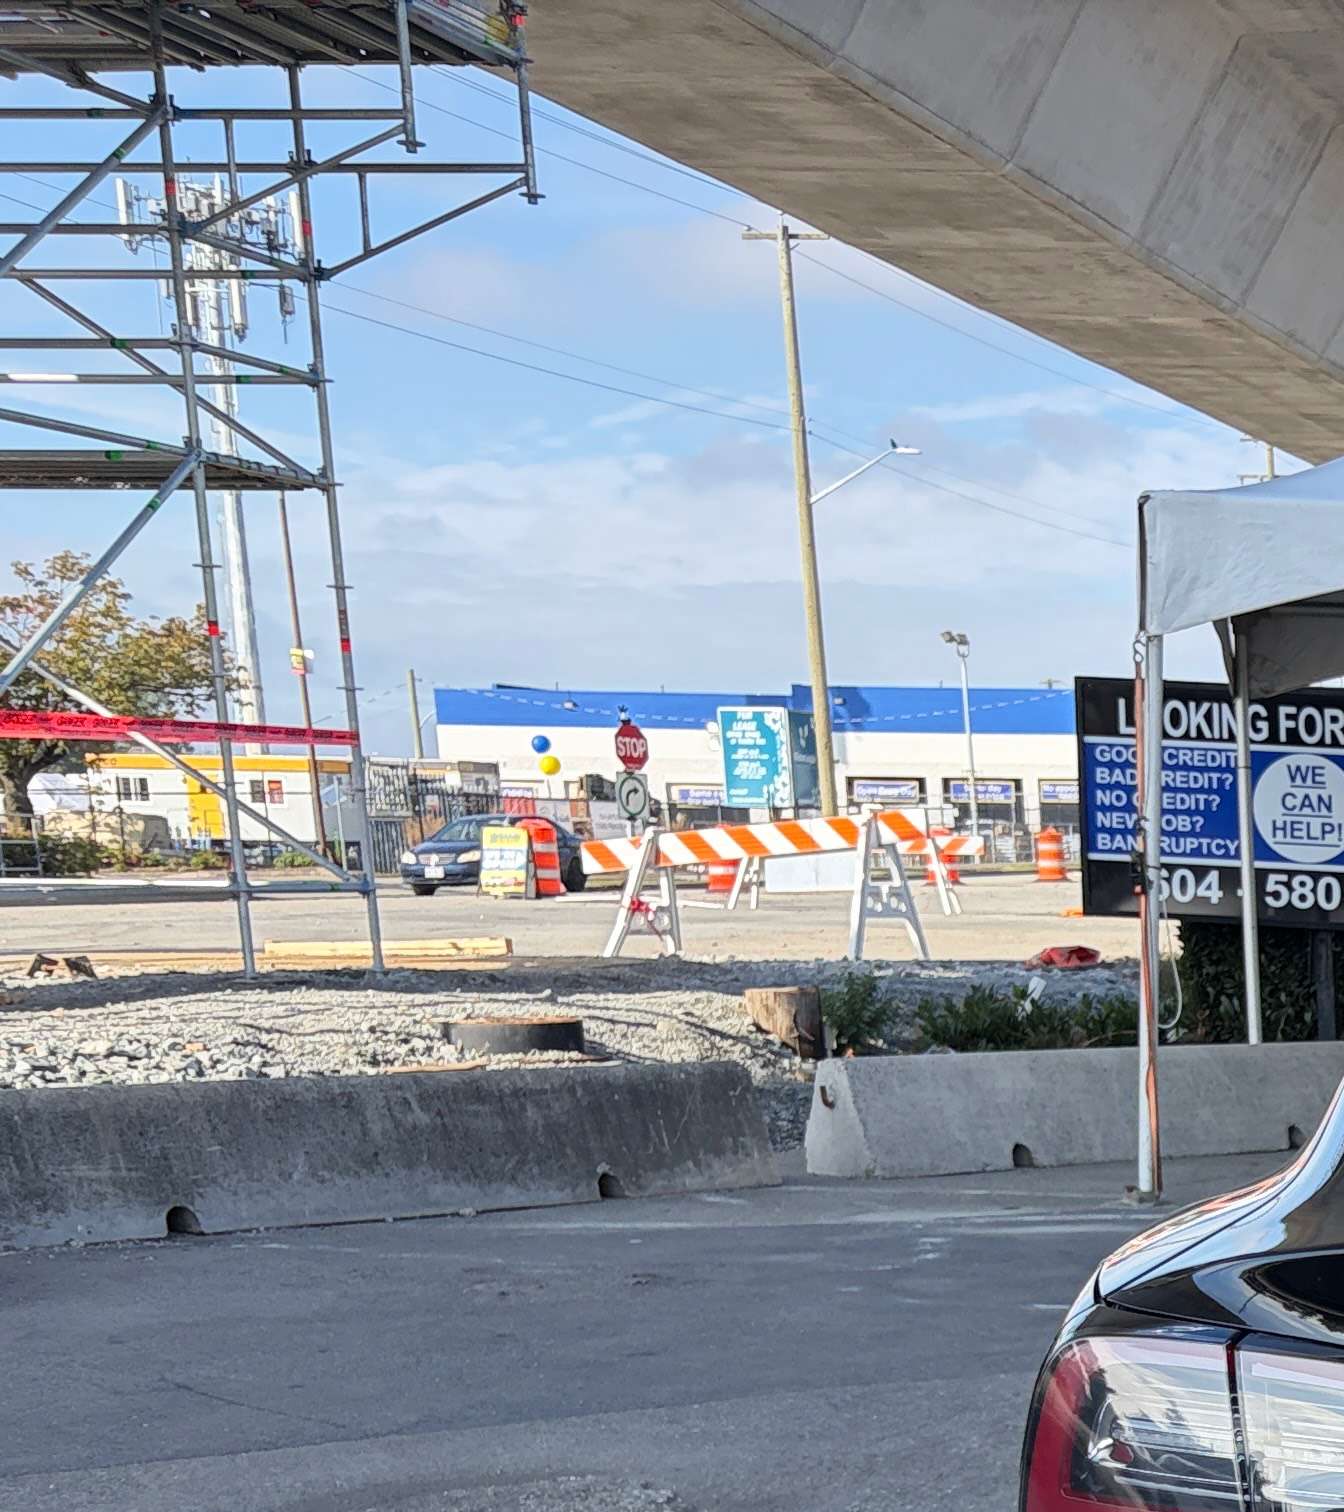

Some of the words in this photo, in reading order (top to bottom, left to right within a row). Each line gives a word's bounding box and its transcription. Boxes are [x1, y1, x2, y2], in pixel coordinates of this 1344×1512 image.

[1117, 697, 1270, 743] LOKING
[617, 736, 647, 759] STOP
[1095, 745, 1137, 763] GOO
[1095, 767, 1138, 786] BAD
[1160, 770, 1234, 790] REDIT?
[1287, 764, 1327, 786] WE
[1095, 789, 1128, 807] NO
[1281, 792, 1333, 814] CAN
[1161, 814, 1205, 833] OB?
[1271, 819, 1344, 843] HELP!
[1097, 833, 1240, 856] BANRUPTCY
[1264, 872, 1342, 912] 580
